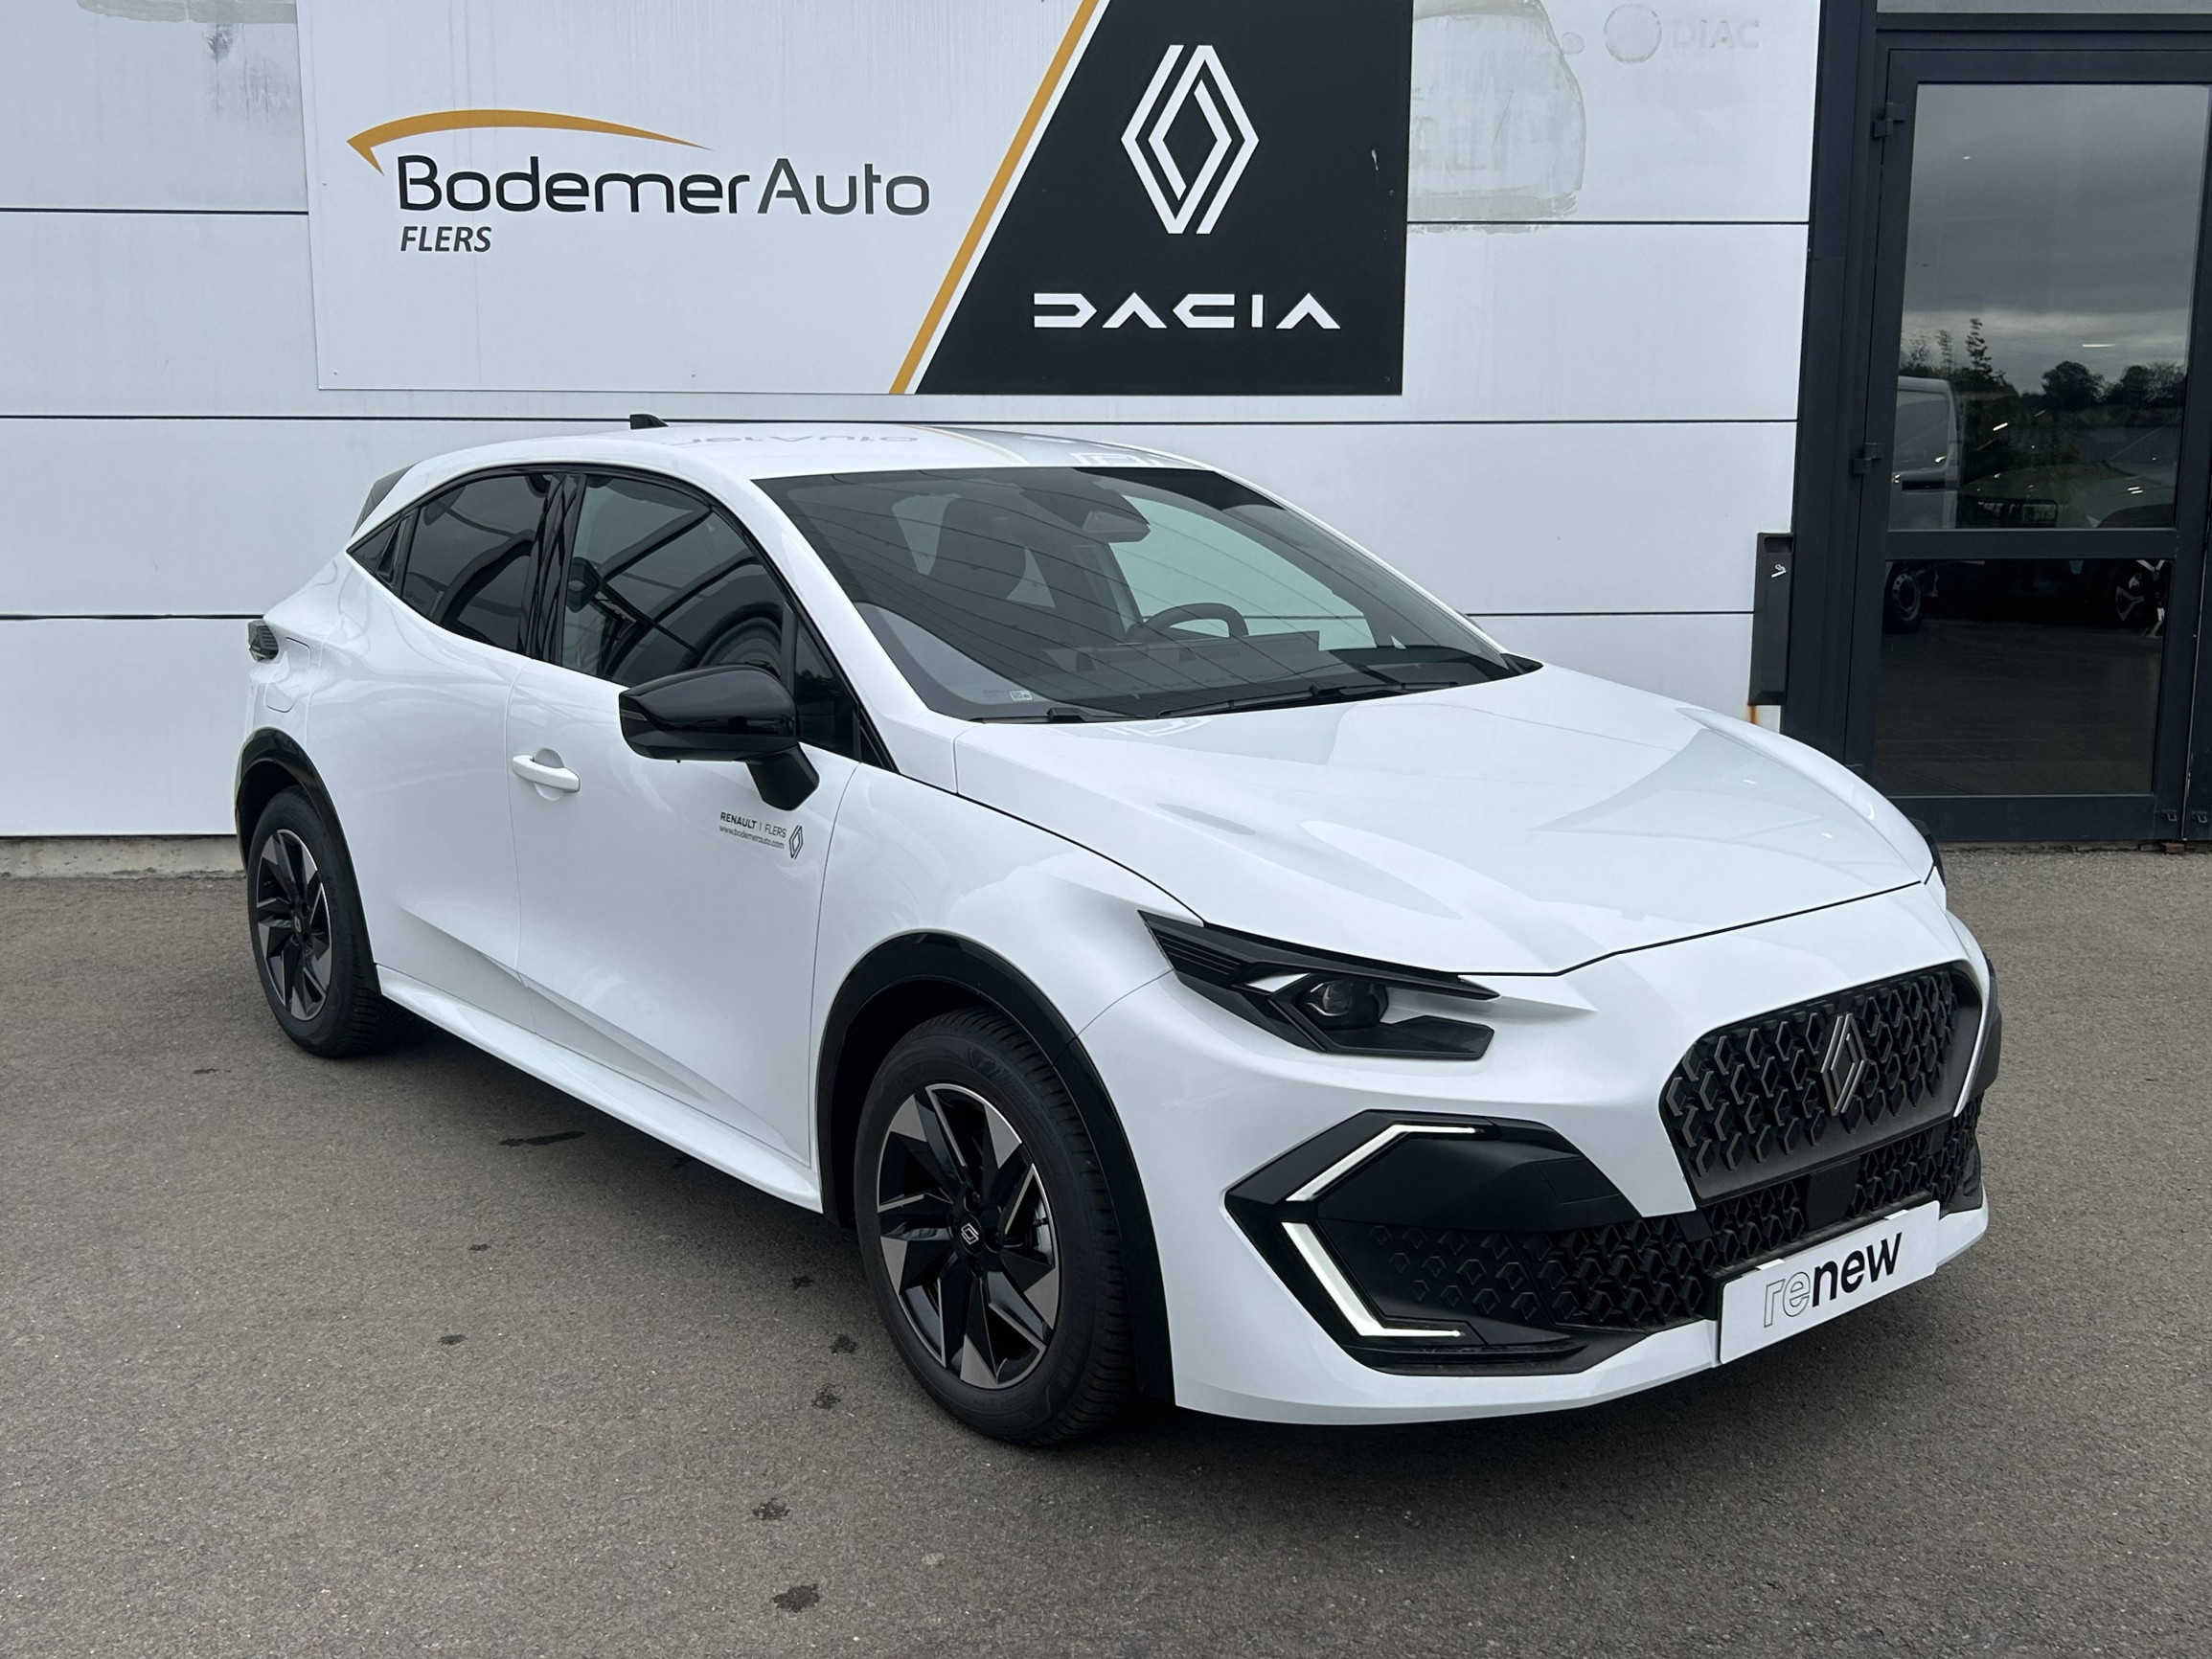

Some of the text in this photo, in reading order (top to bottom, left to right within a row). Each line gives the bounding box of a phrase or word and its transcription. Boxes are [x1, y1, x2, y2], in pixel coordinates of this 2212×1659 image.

[400, 225, 492, 253] FLERS
[1034, 291, 1341, 330] DACIA
[719, 811, 757, 830] RENAULT
[764, 823, 787, 838] FLERS
[1764, 1232, 1903, 1329] renew
